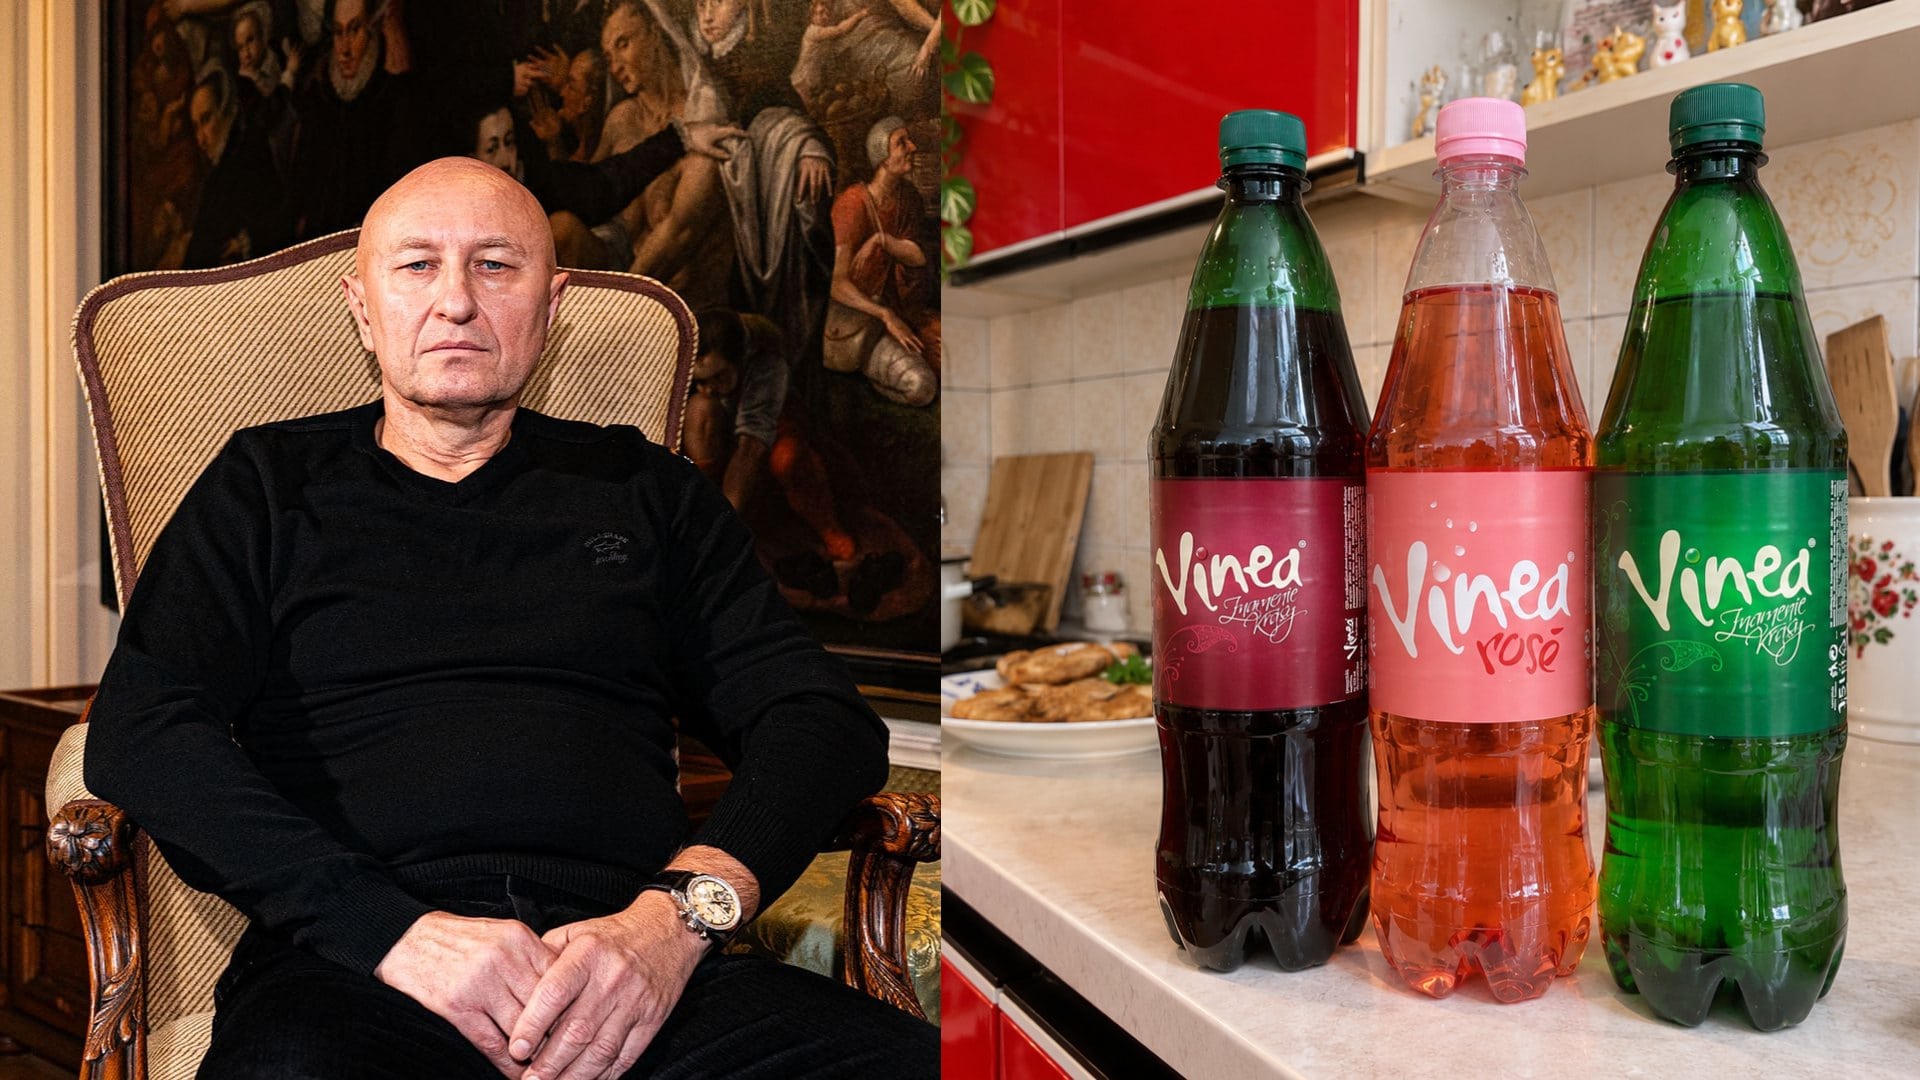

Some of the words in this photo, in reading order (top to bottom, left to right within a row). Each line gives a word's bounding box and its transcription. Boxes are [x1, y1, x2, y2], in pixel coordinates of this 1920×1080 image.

[1155, 531, 1303, 616] Vinea
[1372, 540, 1572, 659] Vinea
[1618, 529, 1813, 632] Vinea
[1476, 627, 1564, 675] rosé
